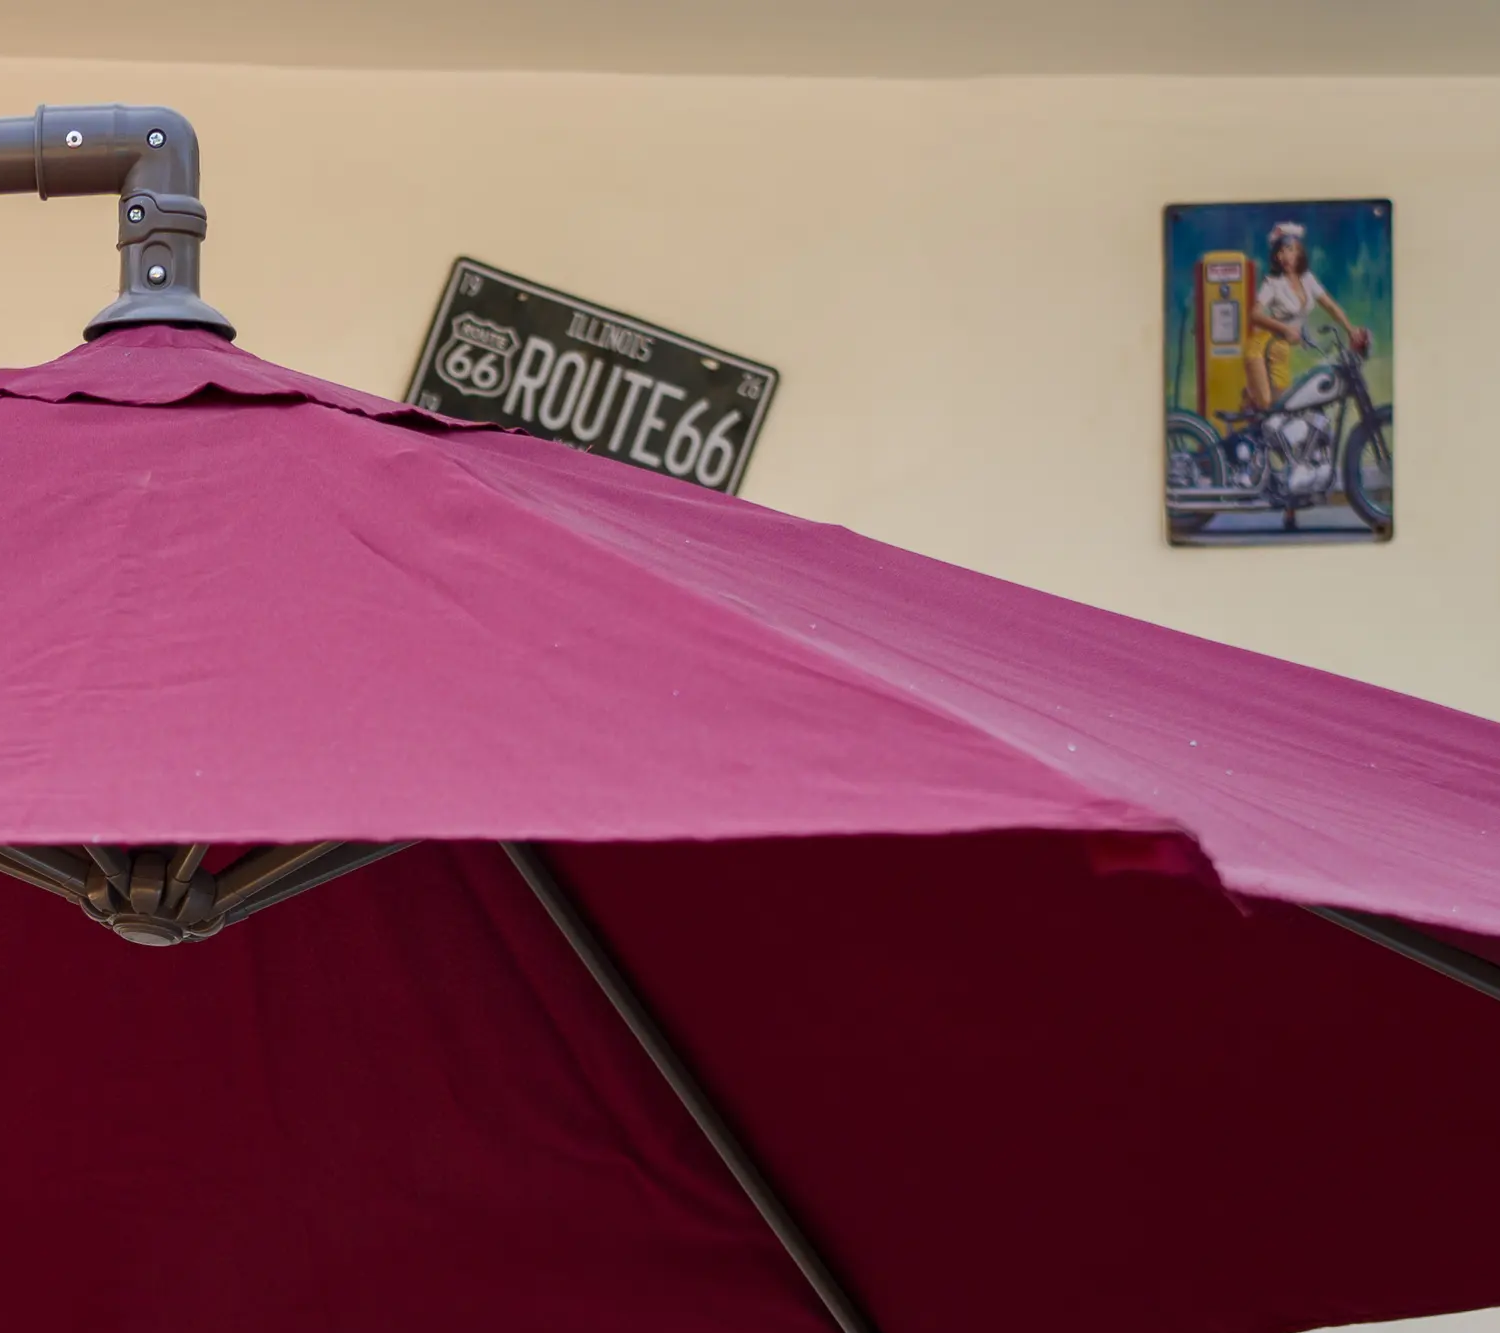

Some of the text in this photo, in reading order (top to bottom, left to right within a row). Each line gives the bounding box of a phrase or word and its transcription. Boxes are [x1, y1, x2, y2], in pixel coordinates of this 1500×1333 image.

[461, 321, 510, 349] ROUTE
[565, 311, 655, 363] ILLINOIS
[445, 344, 500, 390] 66
